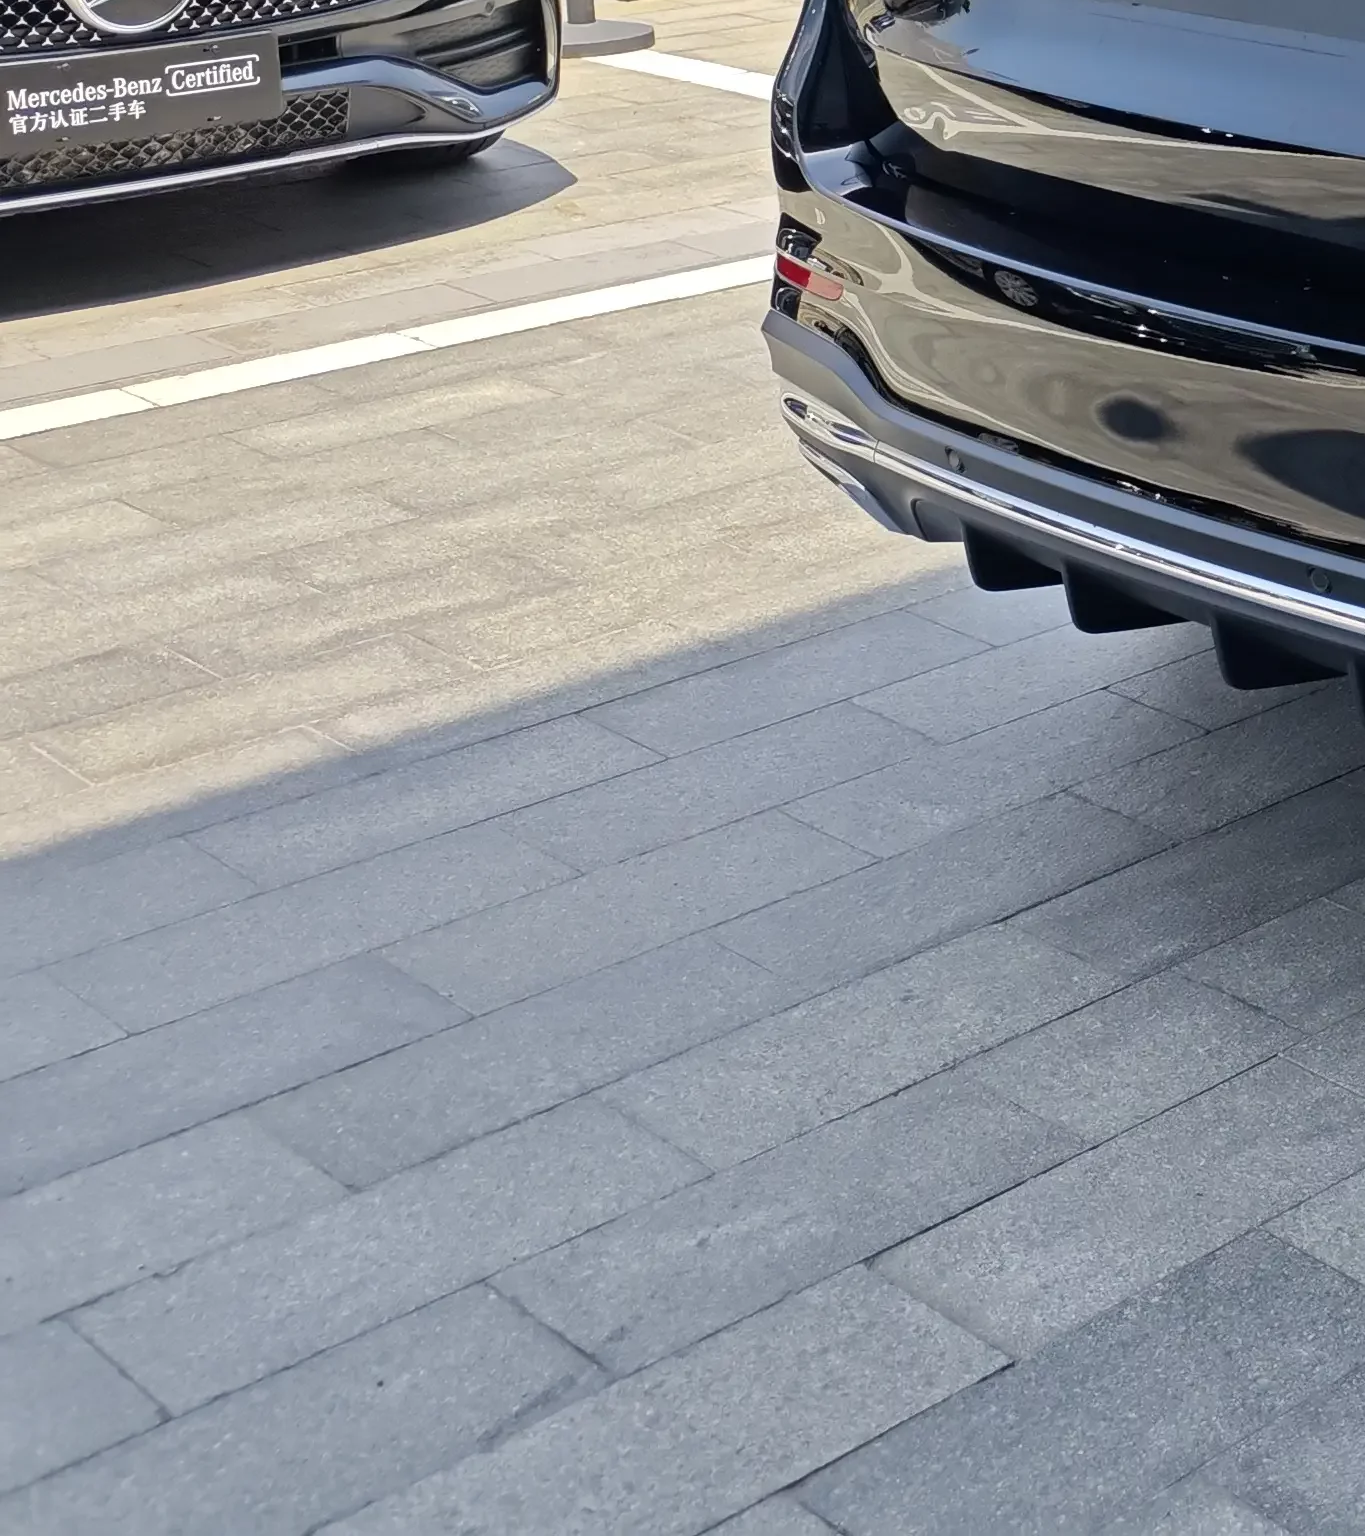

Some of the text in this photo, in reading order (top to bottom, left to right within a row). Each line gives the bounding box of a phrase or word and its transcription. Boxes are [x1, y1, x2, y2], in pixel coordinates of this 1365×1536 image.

[7, 61, 255, 111] Mercedes-Benz Certified
[8, 100, 147, 135] 官方认证二手车
